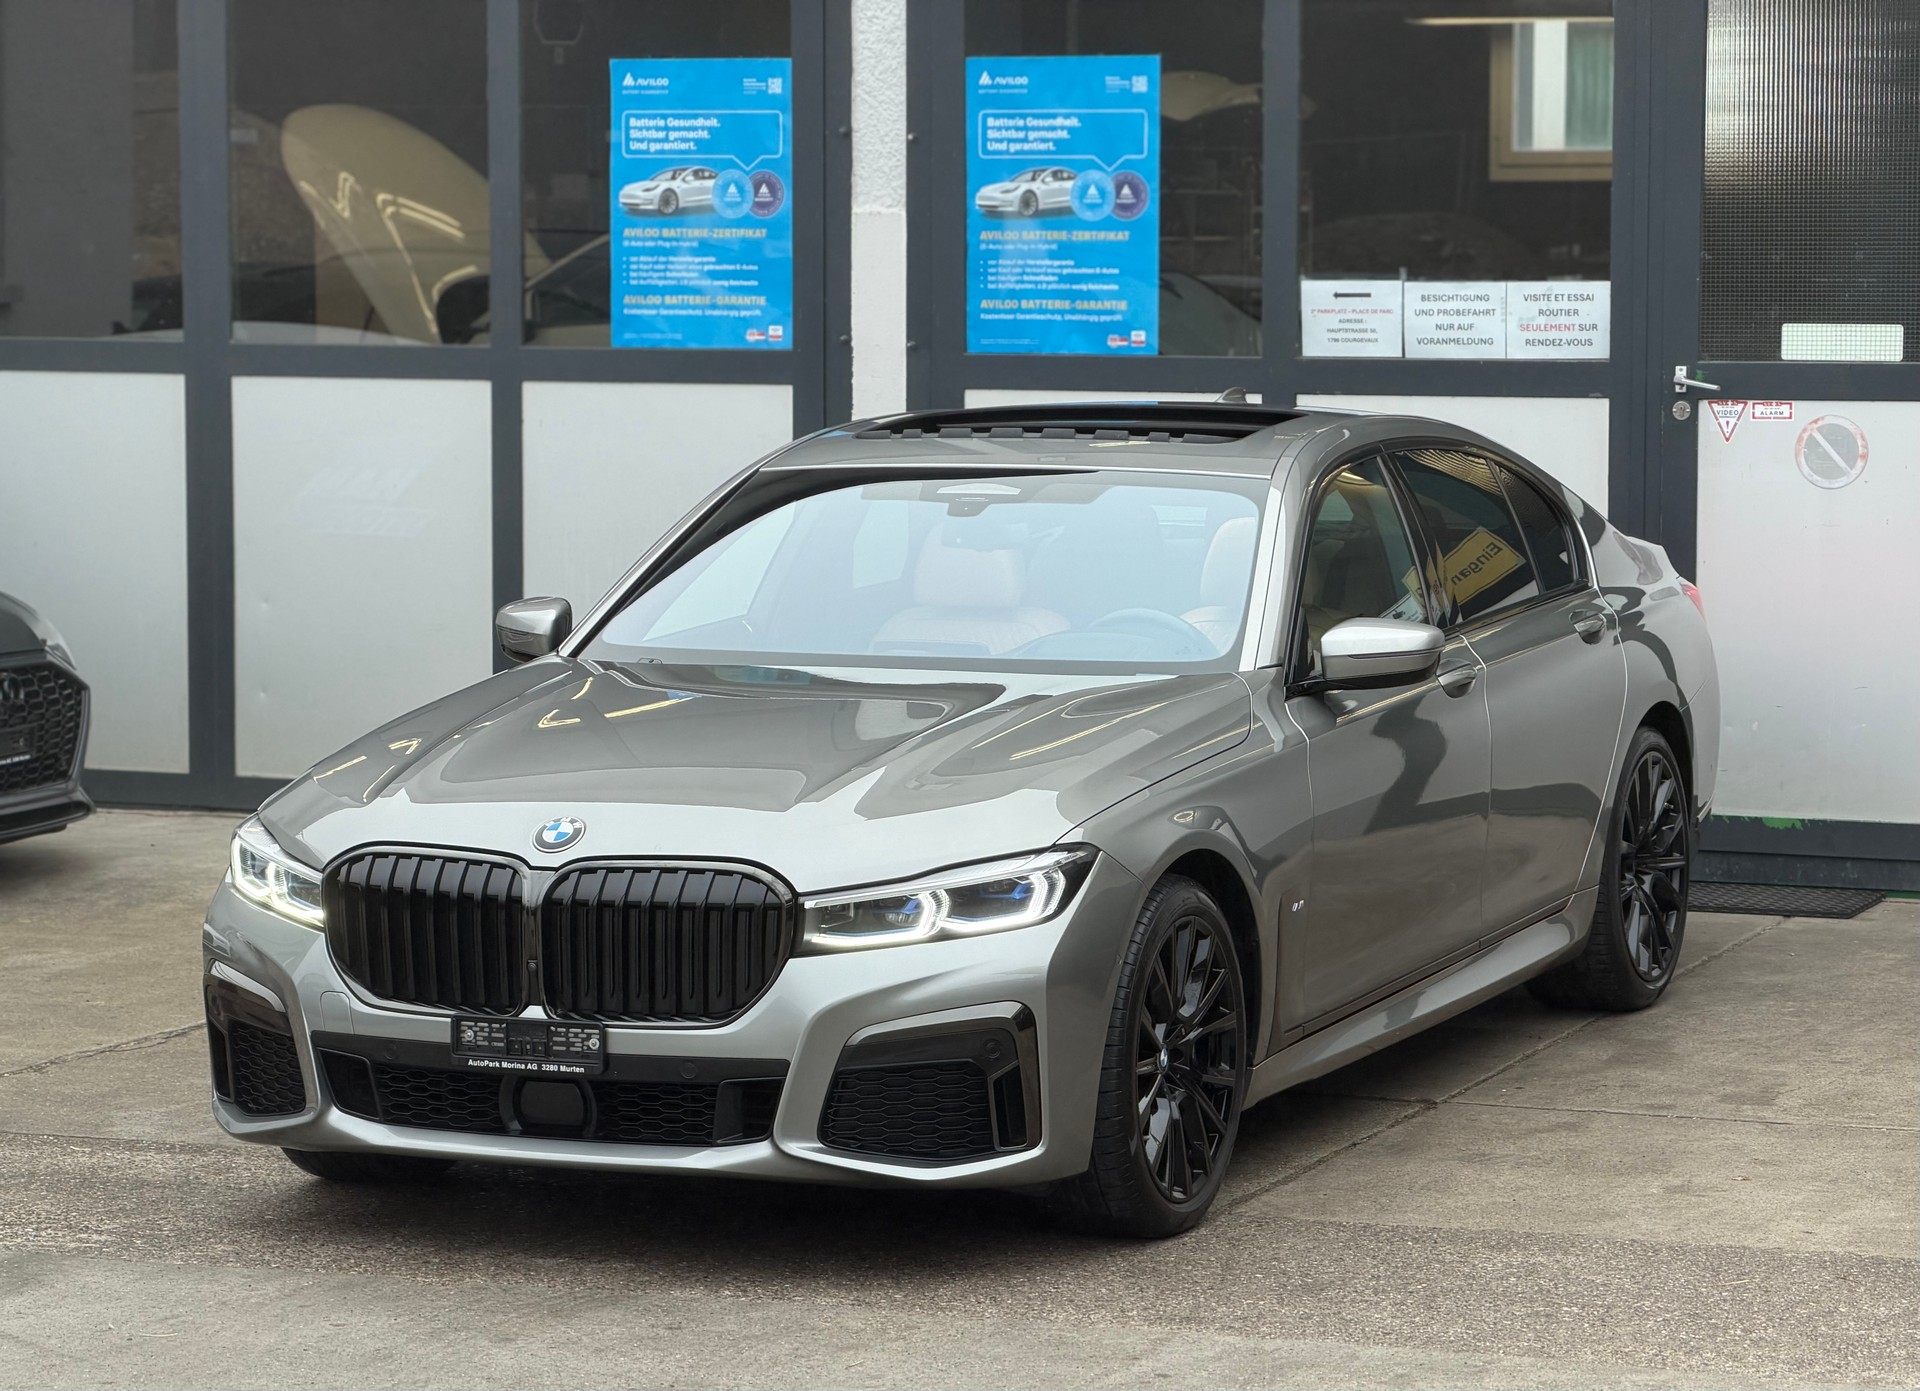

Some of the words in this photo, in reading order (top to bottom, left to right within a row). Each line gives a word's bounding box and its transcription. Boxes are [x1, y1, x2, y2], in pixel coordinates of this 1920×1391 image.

[629, 118, 665, 127] Batterie
[667, 118, 720, 127] Gesundheit.
[987, 117, 1024, 127] Batterie
[1026, 117, 1081, 127] Gesundheit.
[629, 129, 666, 138] Sichtbar
[668, 129, 710, 140] gemacht.
[987, 129, 1026, 138] Sichtbar
[1028, 129, 1070, 141] gemacht.
[630, 141, 647, 150] Und
[649, 141, 697, 152] garantiert.
[987, 141, 1007, 150] Und
[1009, 141, 1056, 152] garantiert.
[623, 228, 659, 238] AVILOO
[980, 231, 1019, 240] AVILOO
[623, 296, 661, 305] AVILOO
[1420, 294, 1490, 302] BESICHTIGUNG
[1524, 294, 1552, 302] VISITE
[1554, 294, 1565, 302] ET
[1568, 294, 1594, 302] ESSAI
[981, 300, 1018, 310] AVILOO
[1414, 308, 1434, 316] UND
[1437, 308, 1496, 316] PROBEFAHRT
[1538, 308, 1580, 317] ROUTIER
[1436, 323, 1454, 331] NUR
[1457, 323, 1474, 331] AUF
[1520, 324, 1576, 332] SEULEMENT
[1578, 324, 1598, 332] SUR
[1416, 338, 1494, 346] VORANMELDUNG
[1525, 338, 1593, 346] RENDEZ-VOUS
[468, 1059, 500, 1068] AutoPark
[502, 1061, 525, 1070] Morina
[527, 1062, 538, 1070] AG
[560, 1065, 584, 1073] Murten
